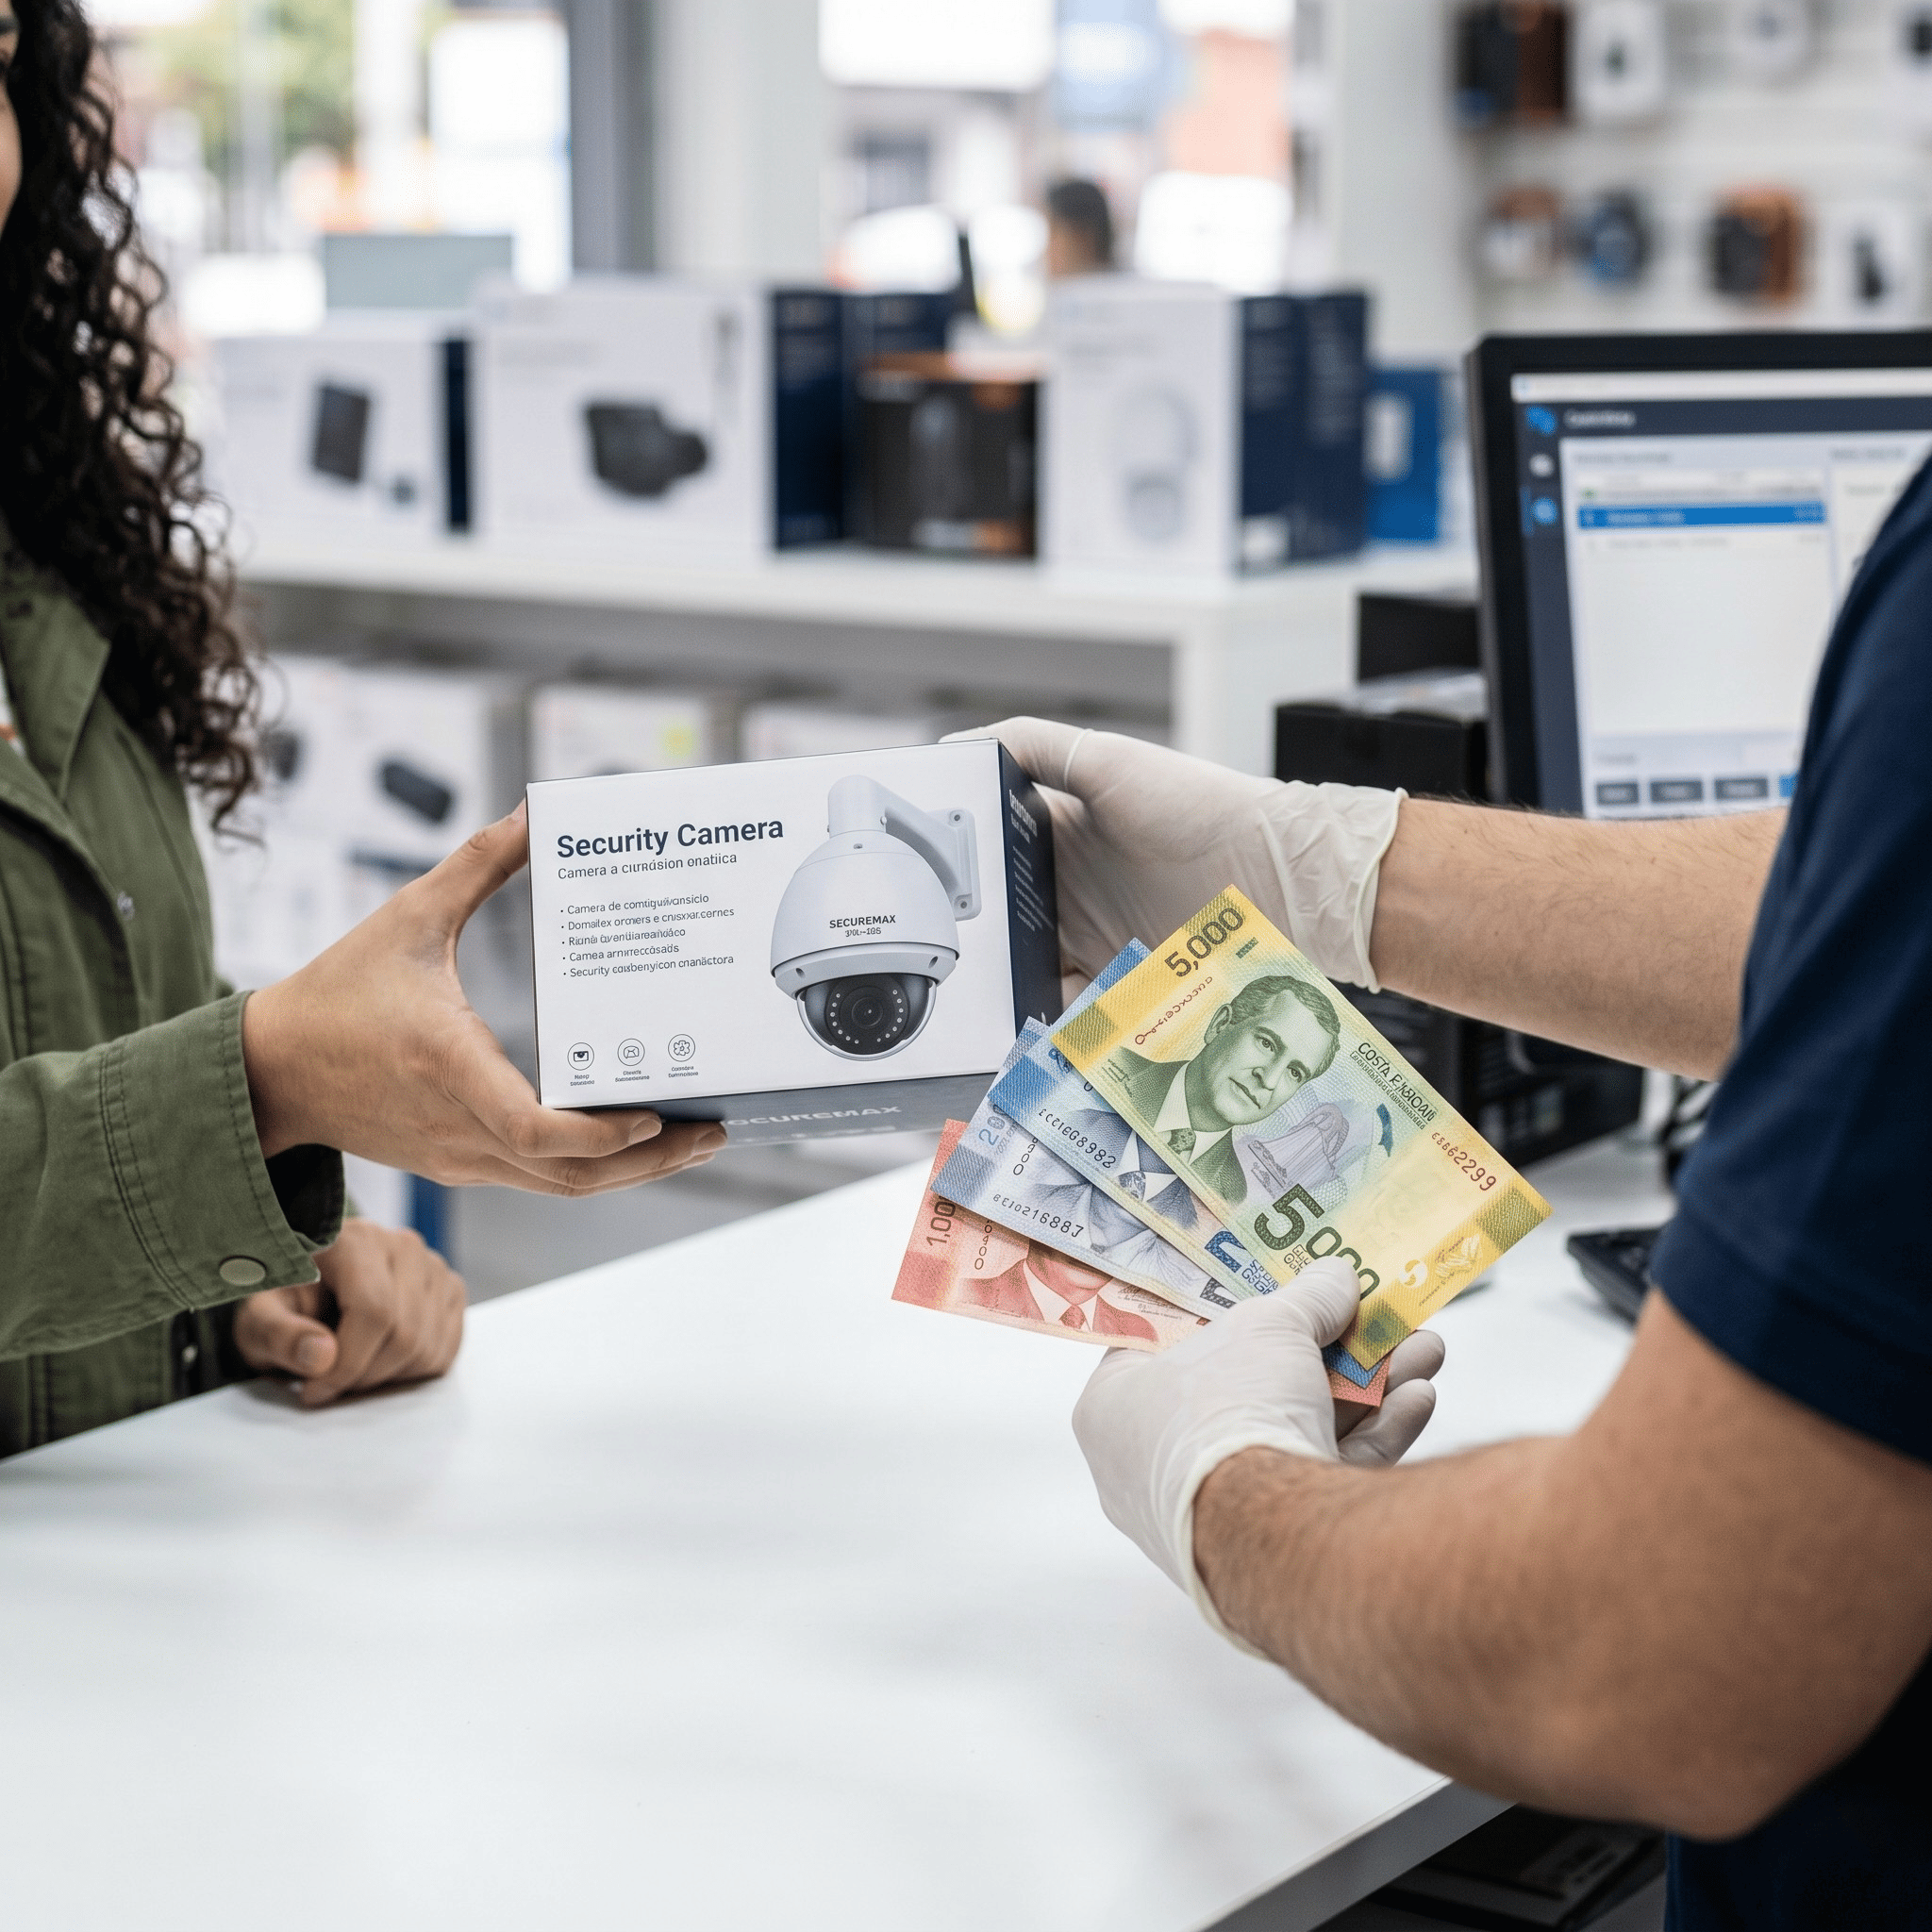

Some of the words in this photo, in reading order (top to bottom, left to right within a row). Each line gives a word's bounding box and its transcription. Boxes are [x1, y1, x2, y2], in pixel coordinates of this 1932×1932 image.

[557, 827, 669, 858] Security
[677, 820, 784, 847] Camera
[558, 863, 607, 879] Camera
[610, 864, 618, 874] a
[567, 904, 606, 915] Camera
[608, 901, 621, 911] de
[829, 914, 896, 928] SECUREMAX
[1164, 908, 1243, 977] 5,000
[570, 965, 610, 977] Security
[1357, 1042, 1391, 1078] COSTA
